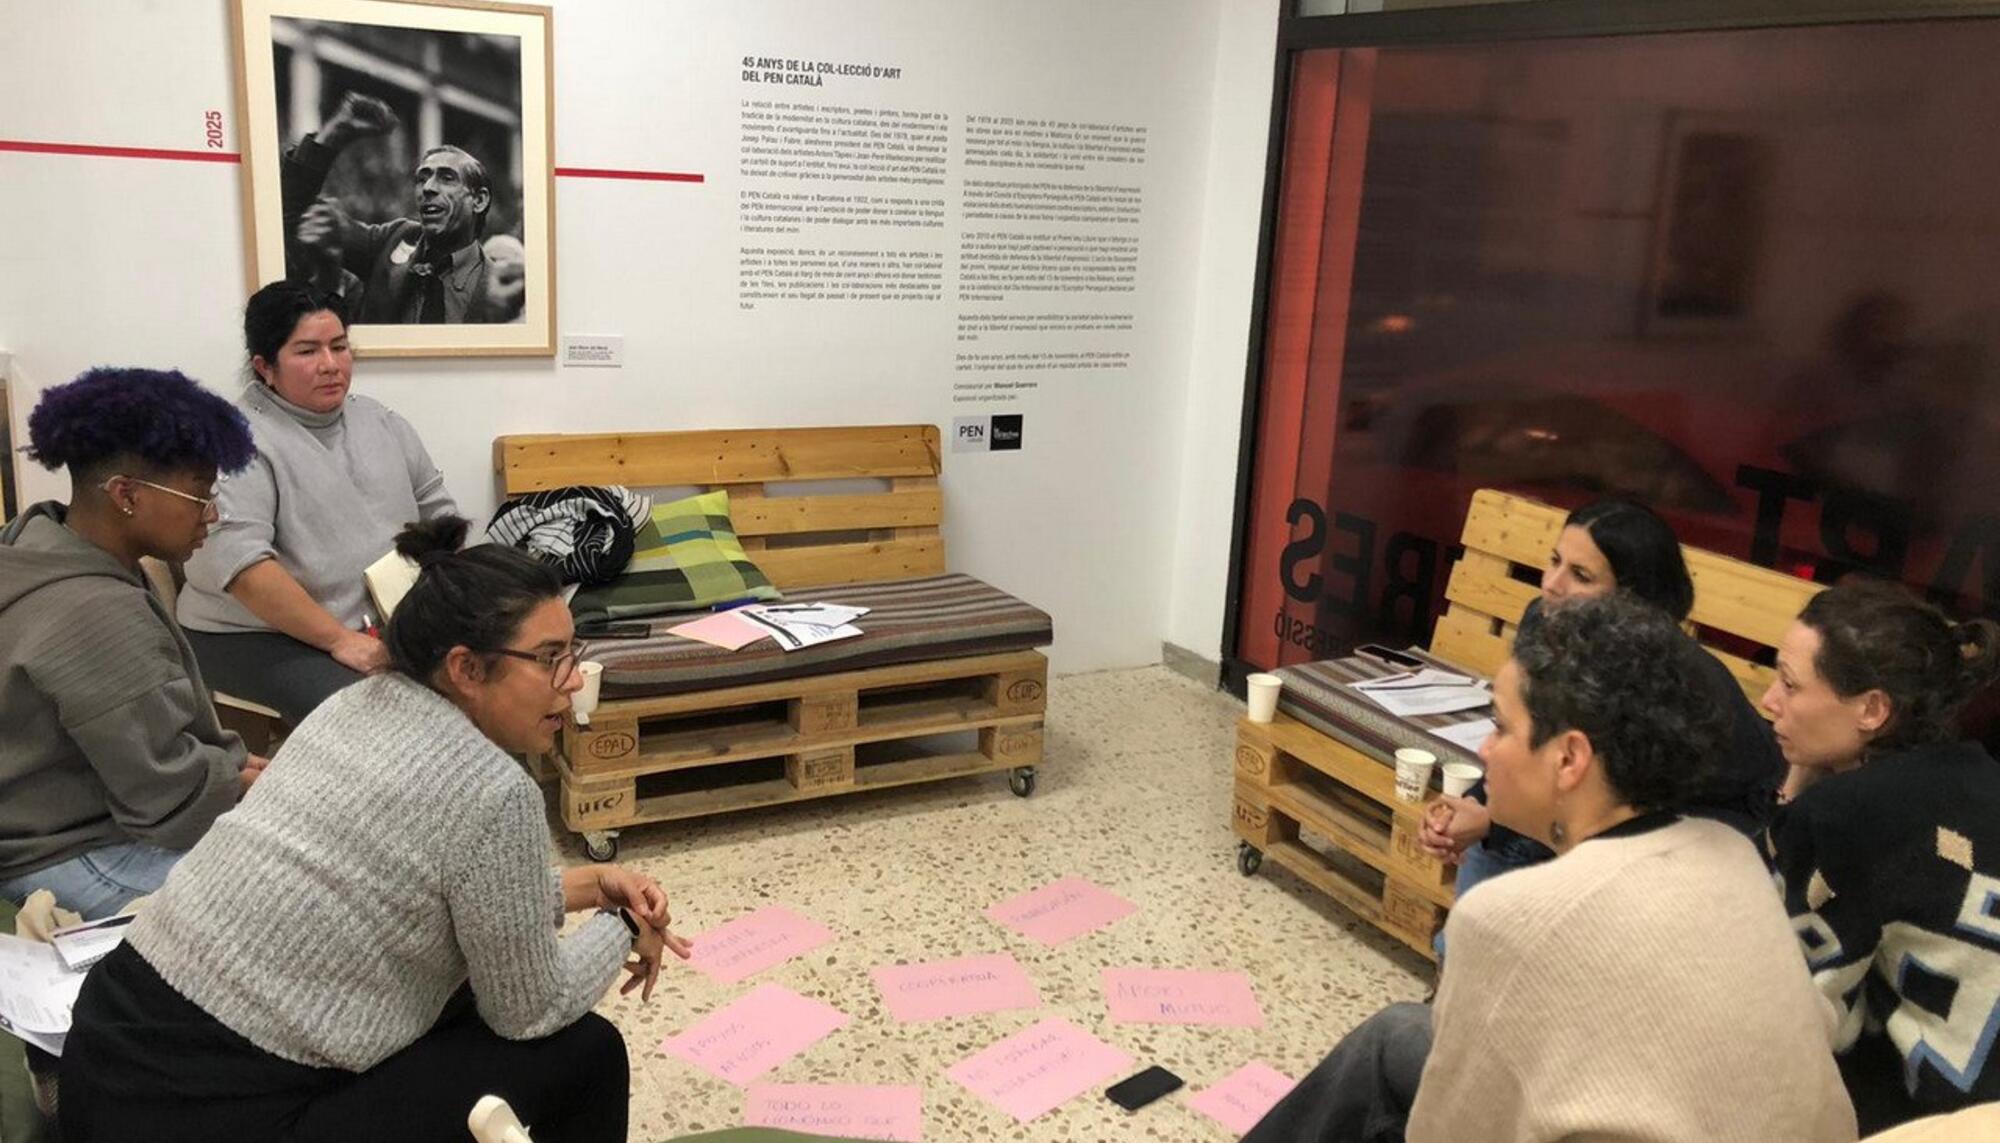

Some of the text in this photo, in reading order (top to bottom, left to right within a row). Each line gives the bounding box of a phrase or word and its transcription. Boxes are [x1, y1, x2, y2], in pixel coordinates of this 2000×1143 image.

[741, 56, 754, 68] 45
[756, 58, 783, 70] ANYS
[786, 60, 798, 71] DE
[801, 61, 814, 72] LA
[741, 69, 823, 85] DEL PEN CATALÀ
[206, 111, 223, 148] 2025
[960, 425, 984, 438] PEN
